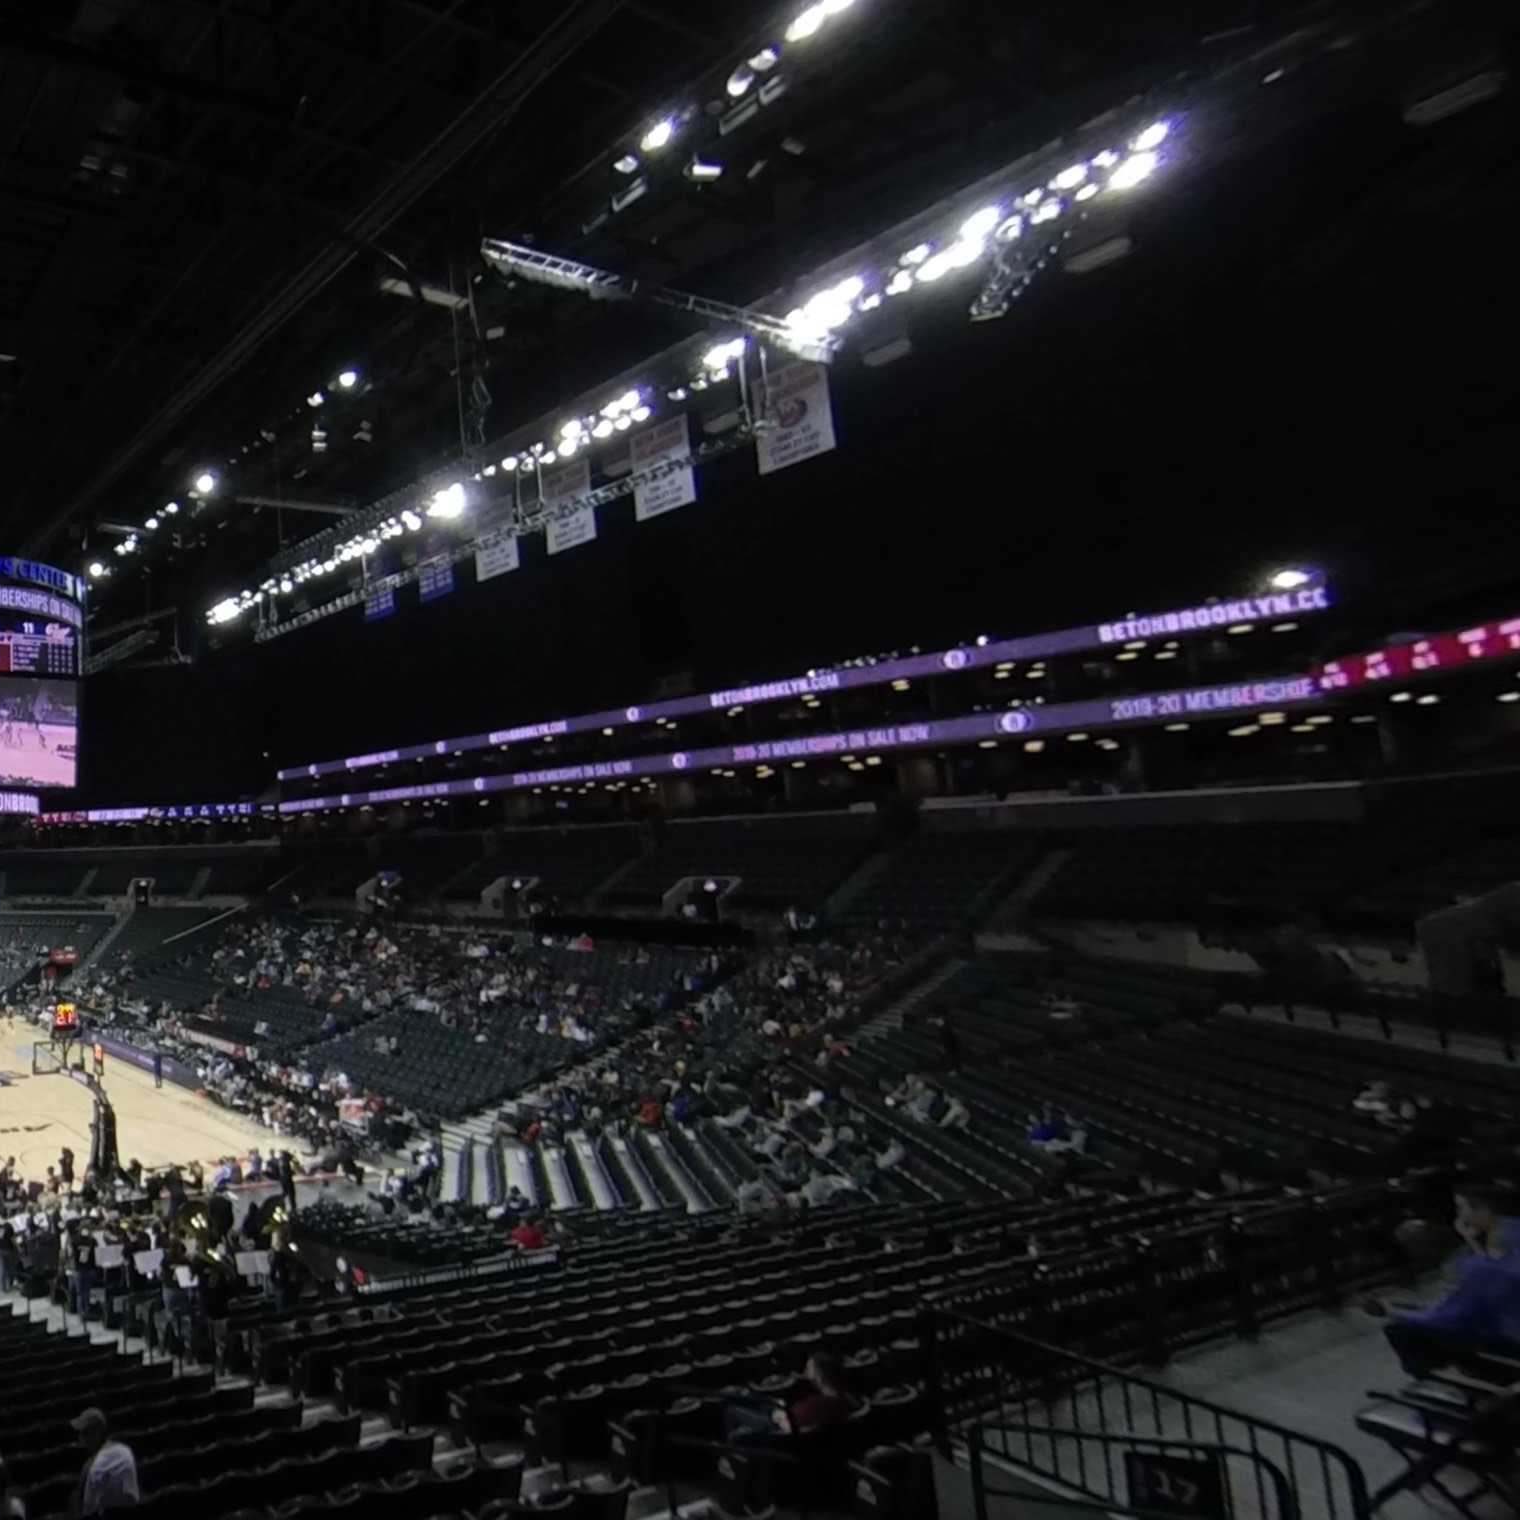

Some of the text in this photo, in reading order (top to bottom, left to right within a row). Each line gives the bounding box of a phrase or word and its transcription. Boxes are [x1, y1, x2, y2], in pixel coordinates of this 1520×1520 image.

[23, 621, 35, 634] 11
[1111, 695, 1181, 720] 2019-20
[868, 729, 896, 746] SALE
